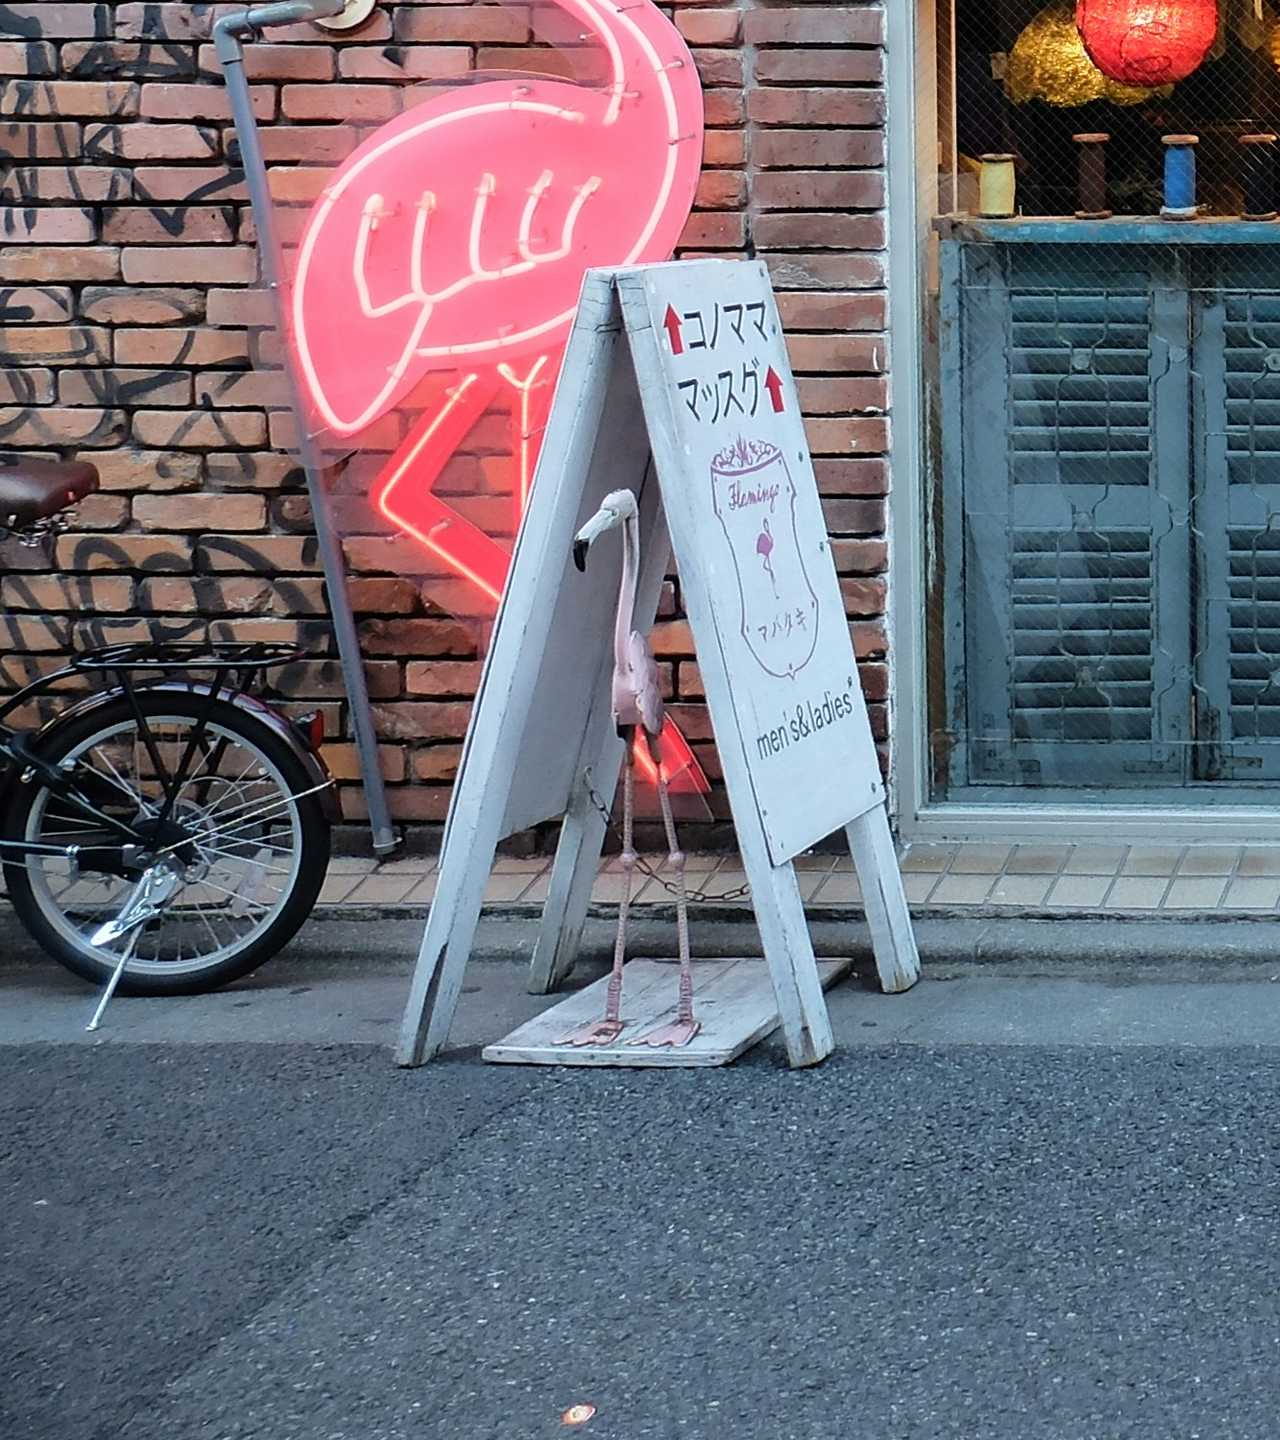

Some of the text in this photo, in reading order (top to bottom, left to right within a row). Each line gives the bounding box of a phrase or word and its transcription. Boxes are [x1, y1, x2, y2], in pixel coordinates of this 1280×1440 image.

[683, 301, 768, 350] コノママ
[677, 356, 760, 424] マッスグ
